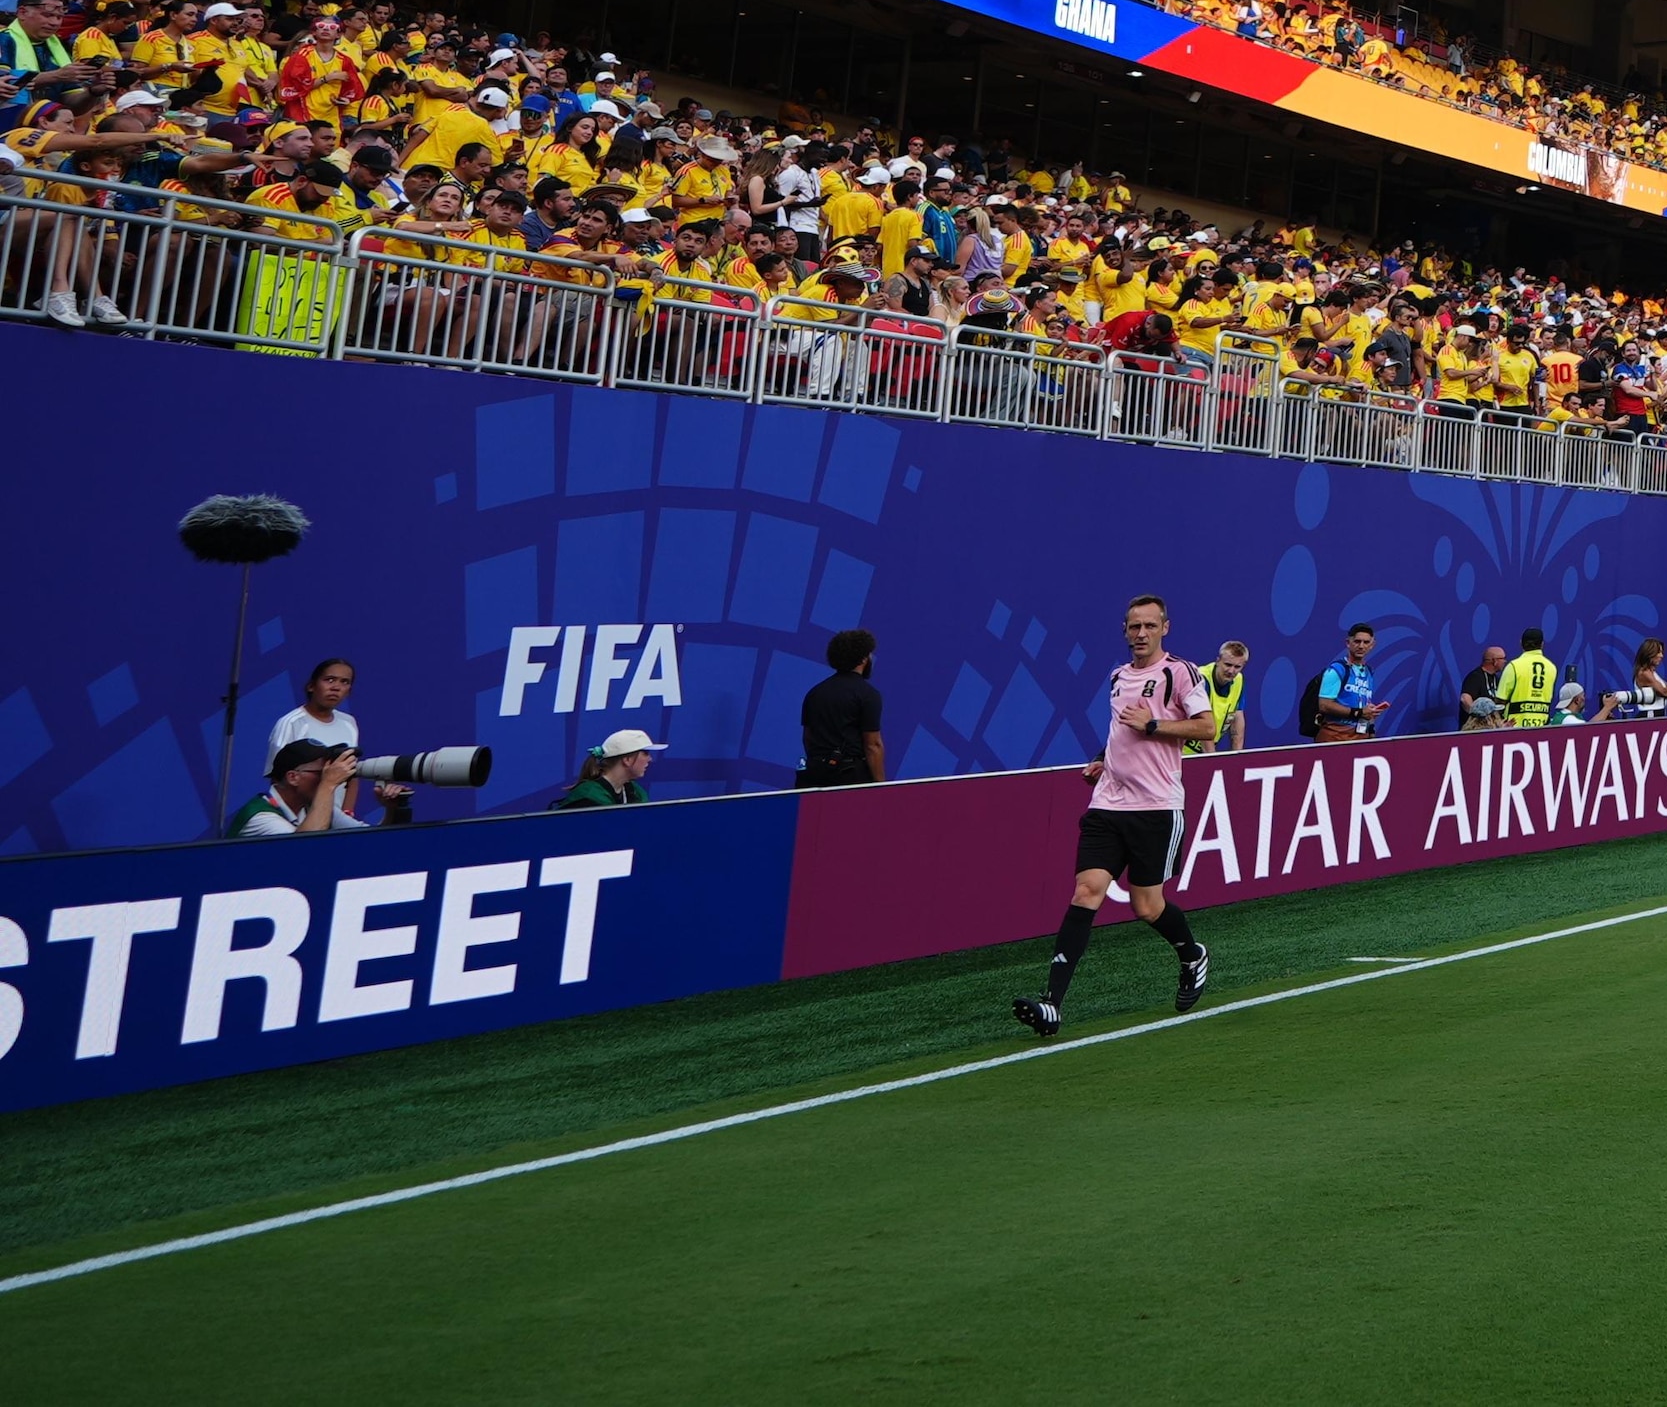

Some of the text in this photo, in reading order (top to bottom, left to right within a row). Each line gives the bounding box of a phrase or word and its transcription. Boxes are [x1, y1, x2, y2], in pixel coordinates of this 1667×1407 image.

[1528, 140, 1586, 186] COLOMBIA
[1551, 363, 1572, 384] 10
[500, 623, 683, 717] FIFA
[1107, 755, 1393, 903] ATAR
